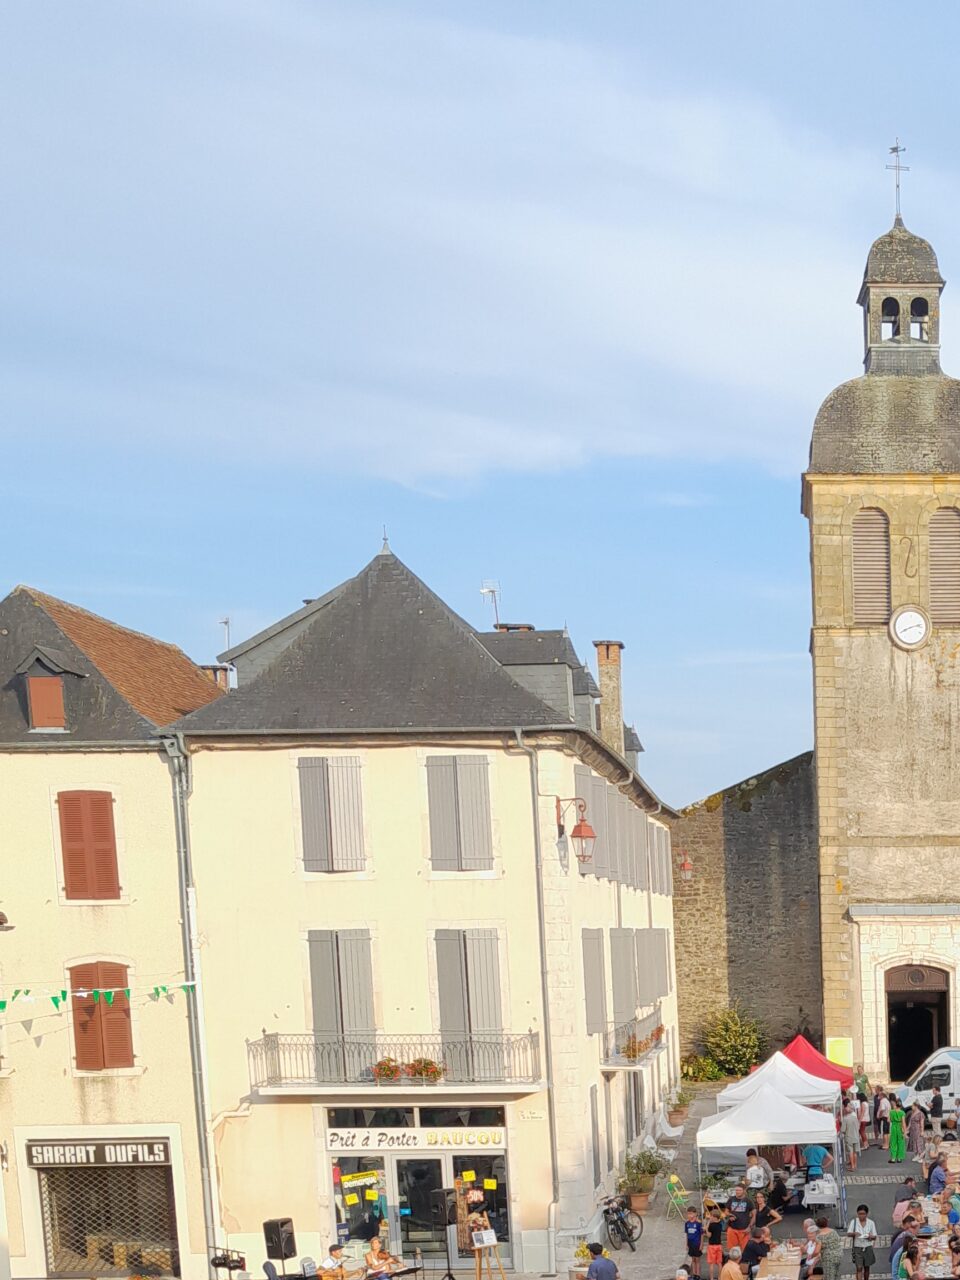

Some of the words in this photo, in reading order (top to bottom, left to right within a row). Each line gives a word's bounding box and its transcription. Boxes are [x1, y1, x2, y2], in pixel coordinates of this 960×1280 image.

[329, 1130, 357, 1147] Prêt
[361, 1130, 370, 1147] à
[377, 1132, 420, 1148] Porter
[426, 1131, 502, 1146] BAUCOU
[31, 1145, 96, 1164] SARRAT
